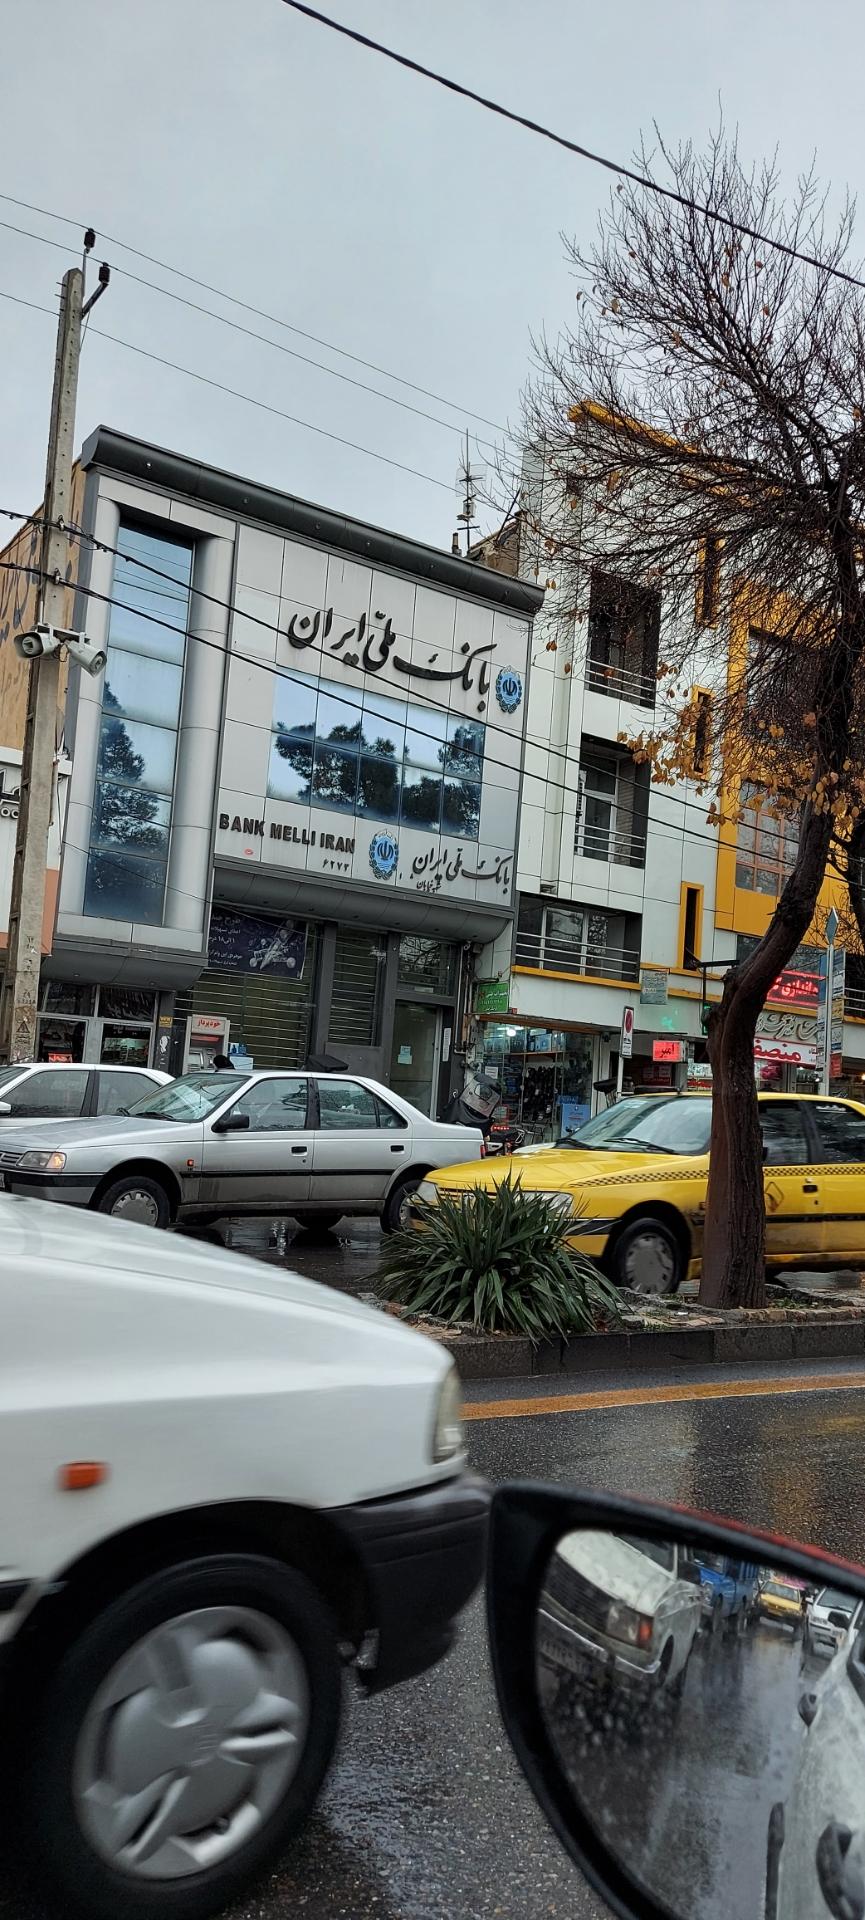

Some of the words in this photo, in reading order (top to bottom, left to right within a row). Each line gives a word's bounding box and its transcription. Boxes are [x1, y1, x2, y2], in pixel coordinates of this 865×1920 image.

[288, 607, 366, 667] ایران
[393, 642, 498, 712] بانک
[219, 813, 265, 838] BANK
[270, 822, 316, 846] MELLI
[320, 832, 355, 854] IRAN
[412, 847, 448, 881] ایران
[461, 855, 513, 894] بانک
